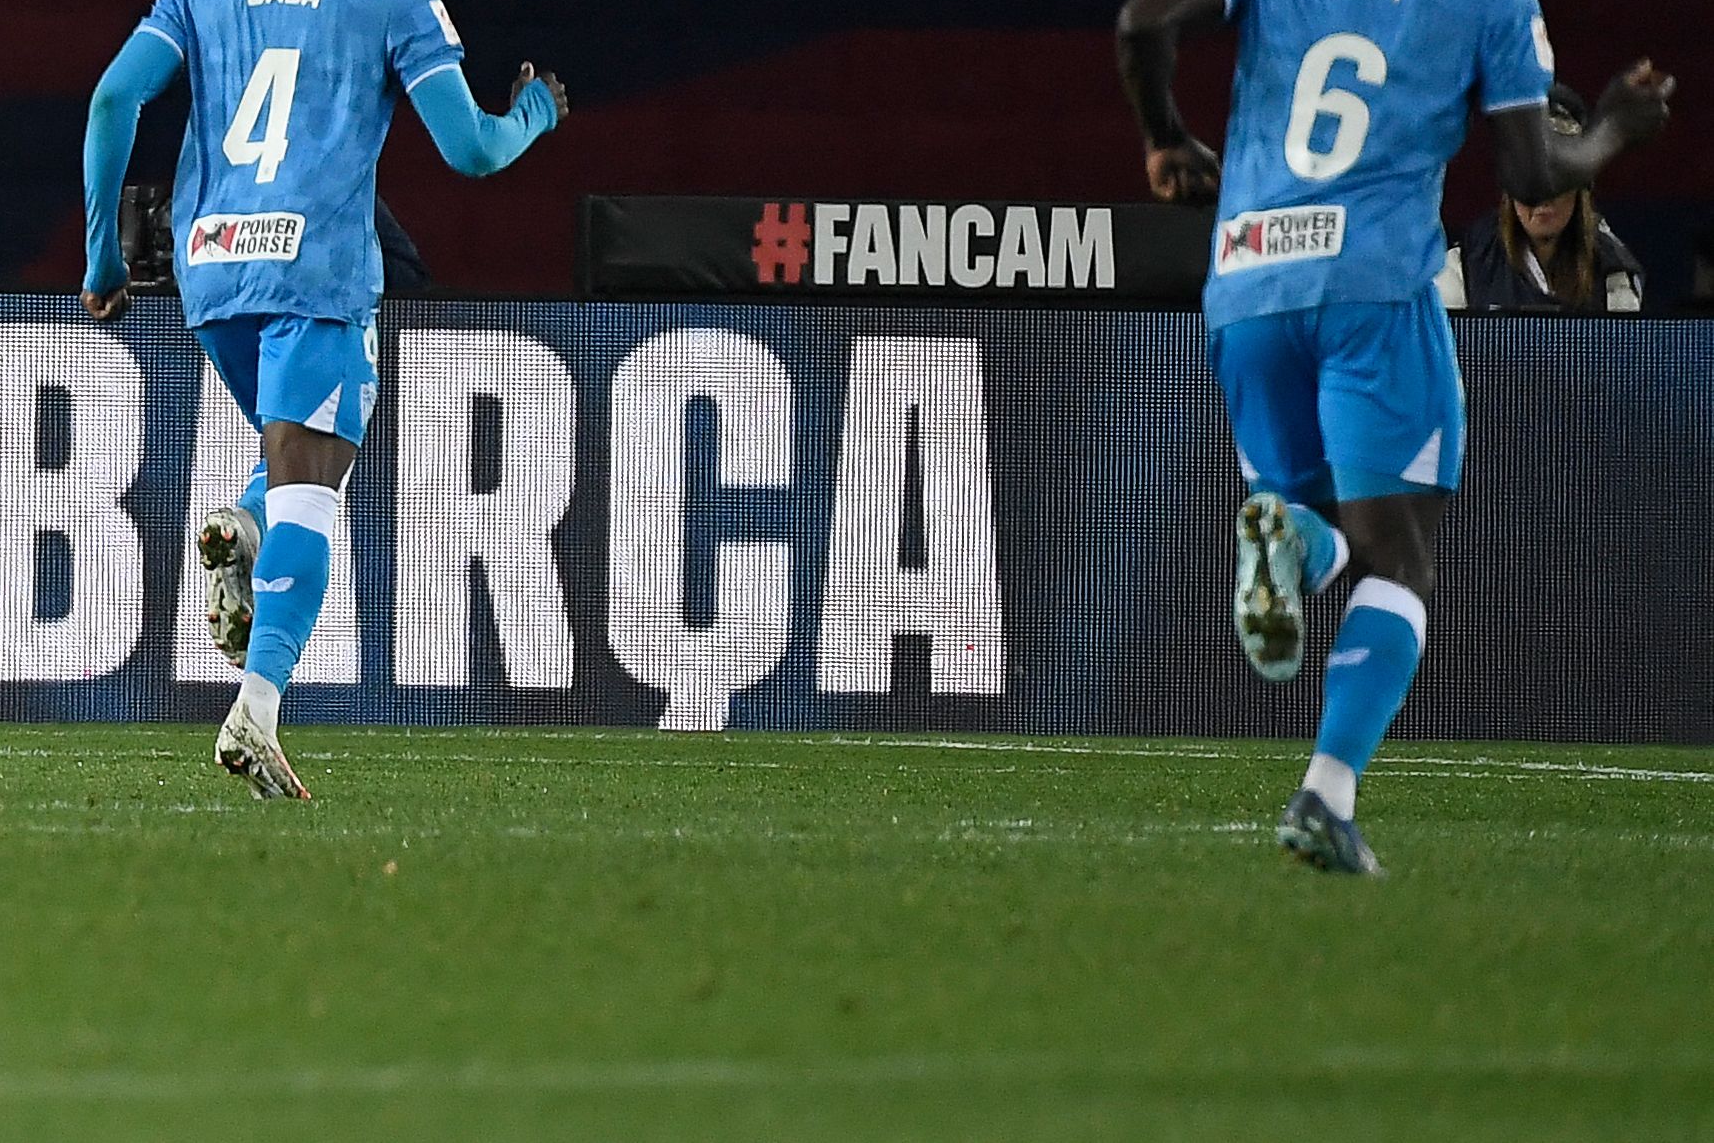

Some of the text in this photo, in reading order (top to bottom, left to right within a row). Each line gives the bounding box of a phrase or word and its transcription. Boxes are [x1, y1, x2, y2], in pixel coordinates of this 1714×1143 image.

[222, 47, 301, 184] 4
[1284, 31, 1387, 182] 6
[238, 217, 298, 236] POWER
[1267, 211, 1337, 232] POWER
[235, 235, 295, 255] HORSE
[751, 202, 1115, 289] #FANCAM
[1266, 232, 1334, 256] HORSE
